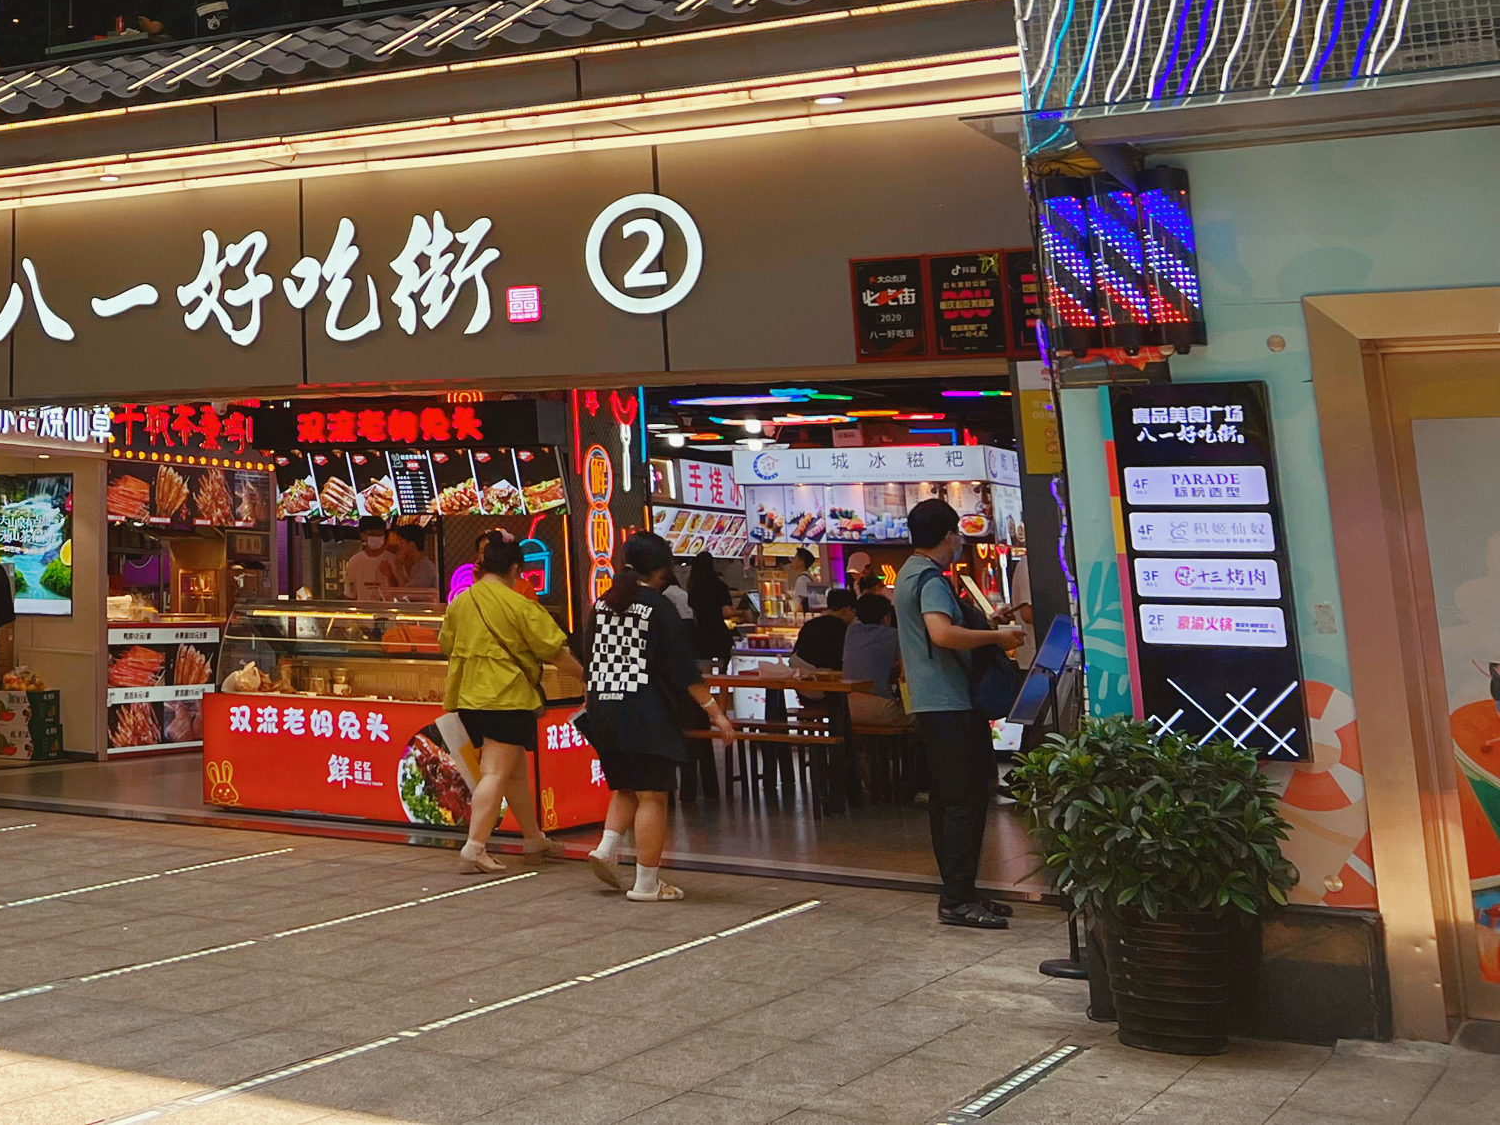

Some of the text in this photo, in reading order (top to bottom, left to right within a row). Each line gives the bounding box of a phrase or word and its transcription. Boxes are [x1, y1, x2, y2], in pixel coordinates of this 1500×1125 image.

[880, 313, 902, 323] 2020
[869, 329, 915, 339] 八一好吃街
[1132, 405, 1244, 424] 高品美食广场
[297, 407, 484, 443] 双流老妈兔头
[1137, 424, 1238, 443] 八一好吃街
[795, 450, 964, 470] 山城冰糍粑
[1133, 479, 1148, 489] 4F
[1171, 474, 1240, 484] PARADE
[1138, 525, 1153, 535] 4F
[1143, 571, 1159, 581] 3F
[1149, 615, 1164, 625] 2F
[1178, 616, 1233, 631] 豪渝火锅
[229, 705, 390, 743] 双流老妈兔头
[327, 754, 353, 789] 鲜
